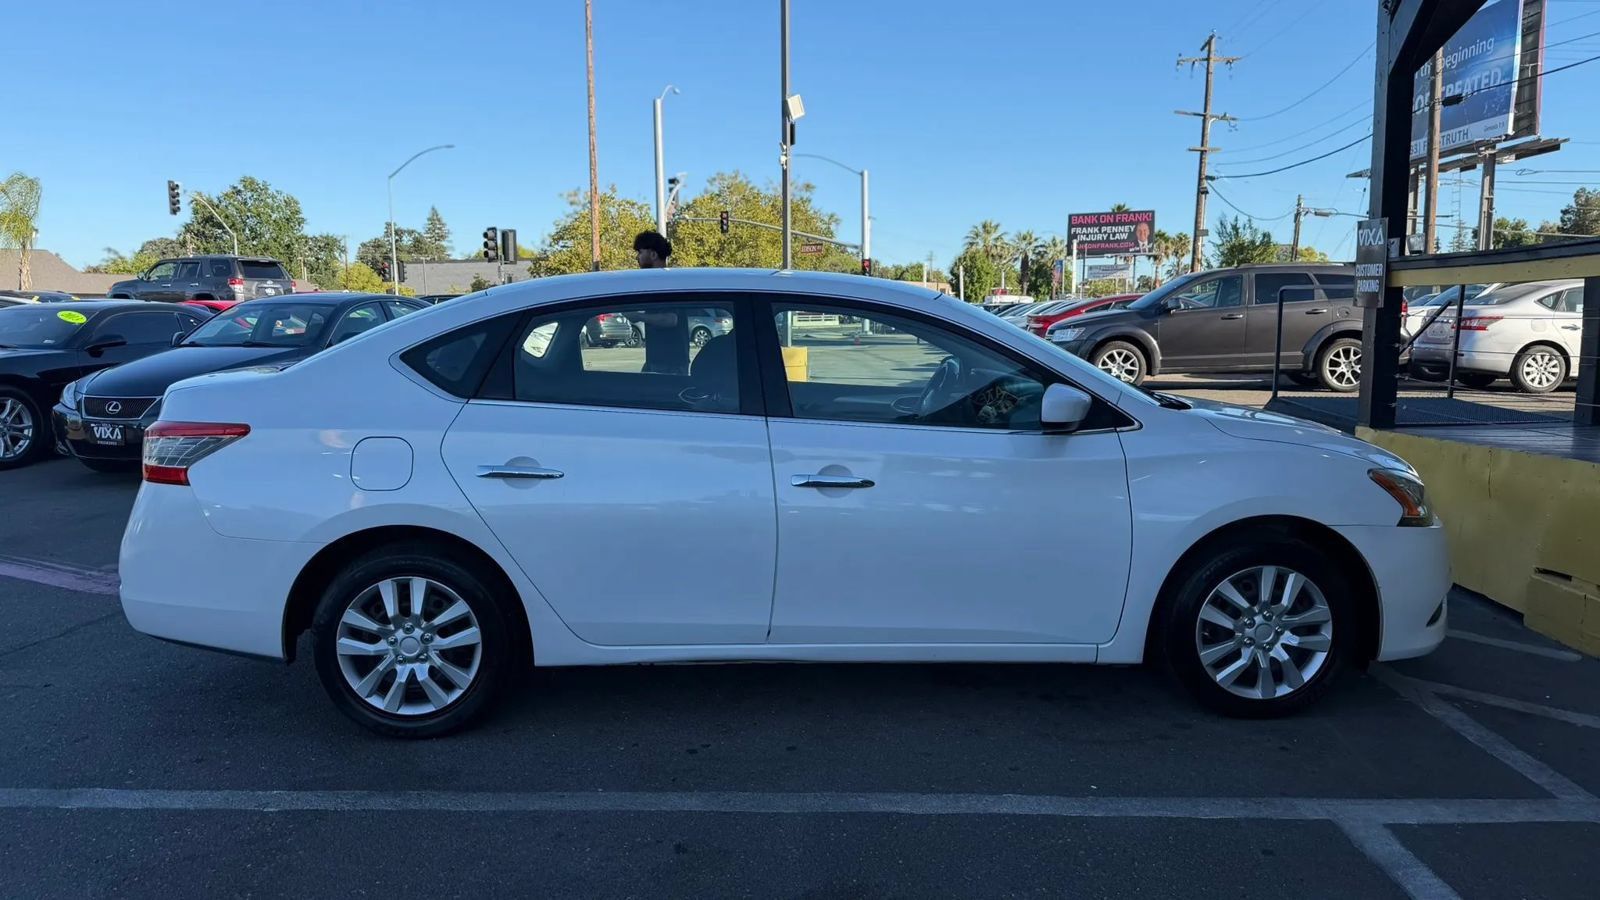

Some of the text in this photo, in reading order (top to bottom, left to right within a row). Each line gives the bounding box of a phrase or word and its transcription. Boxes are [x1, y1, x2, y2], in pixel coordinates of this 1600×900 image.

[1071, 213, 1152, 224] BANK ON FRANK!
[1101, 225, 1135, 233] PENNEY
[1359, 228, 1384, 246] VIXA
[1356, 264, 1383, 276] CUSTOMER
[1358, 280, 1379, 292] PARKING
[93, 426, 122, 440] VIXA
